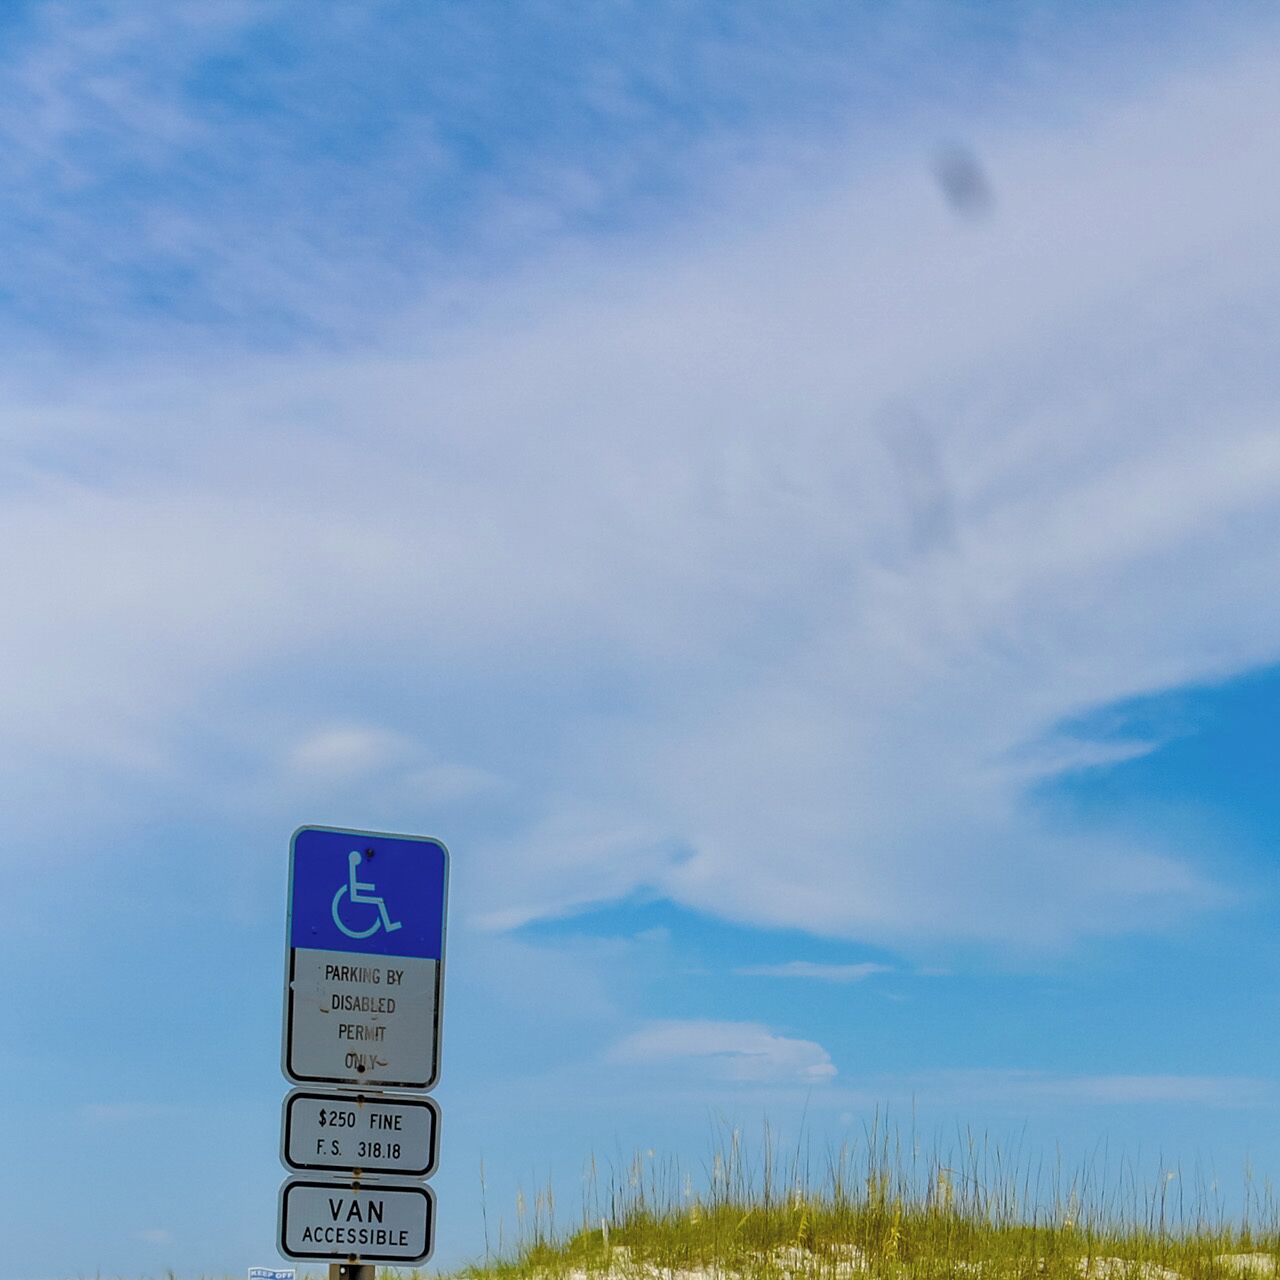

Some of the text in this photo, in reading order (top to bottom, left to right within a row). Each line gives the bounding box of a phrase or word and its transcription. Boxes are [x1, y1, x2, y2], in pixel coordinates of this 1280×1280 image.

[326, 965, 404, 985] PARKING BY
[332, 994, 395, 1013] DISABLED
[339, 1024, 386, 1041] PERMIT
[345, 1053, 378, 1070] ONLY
[319, 1109, 402, 1130] $250 FINE
[358, 1142, 401, 1159] 318.18
[329, 1199, 383, 1223] VAN
[303, 1227, 408, 1246] ACCESSIBLE
